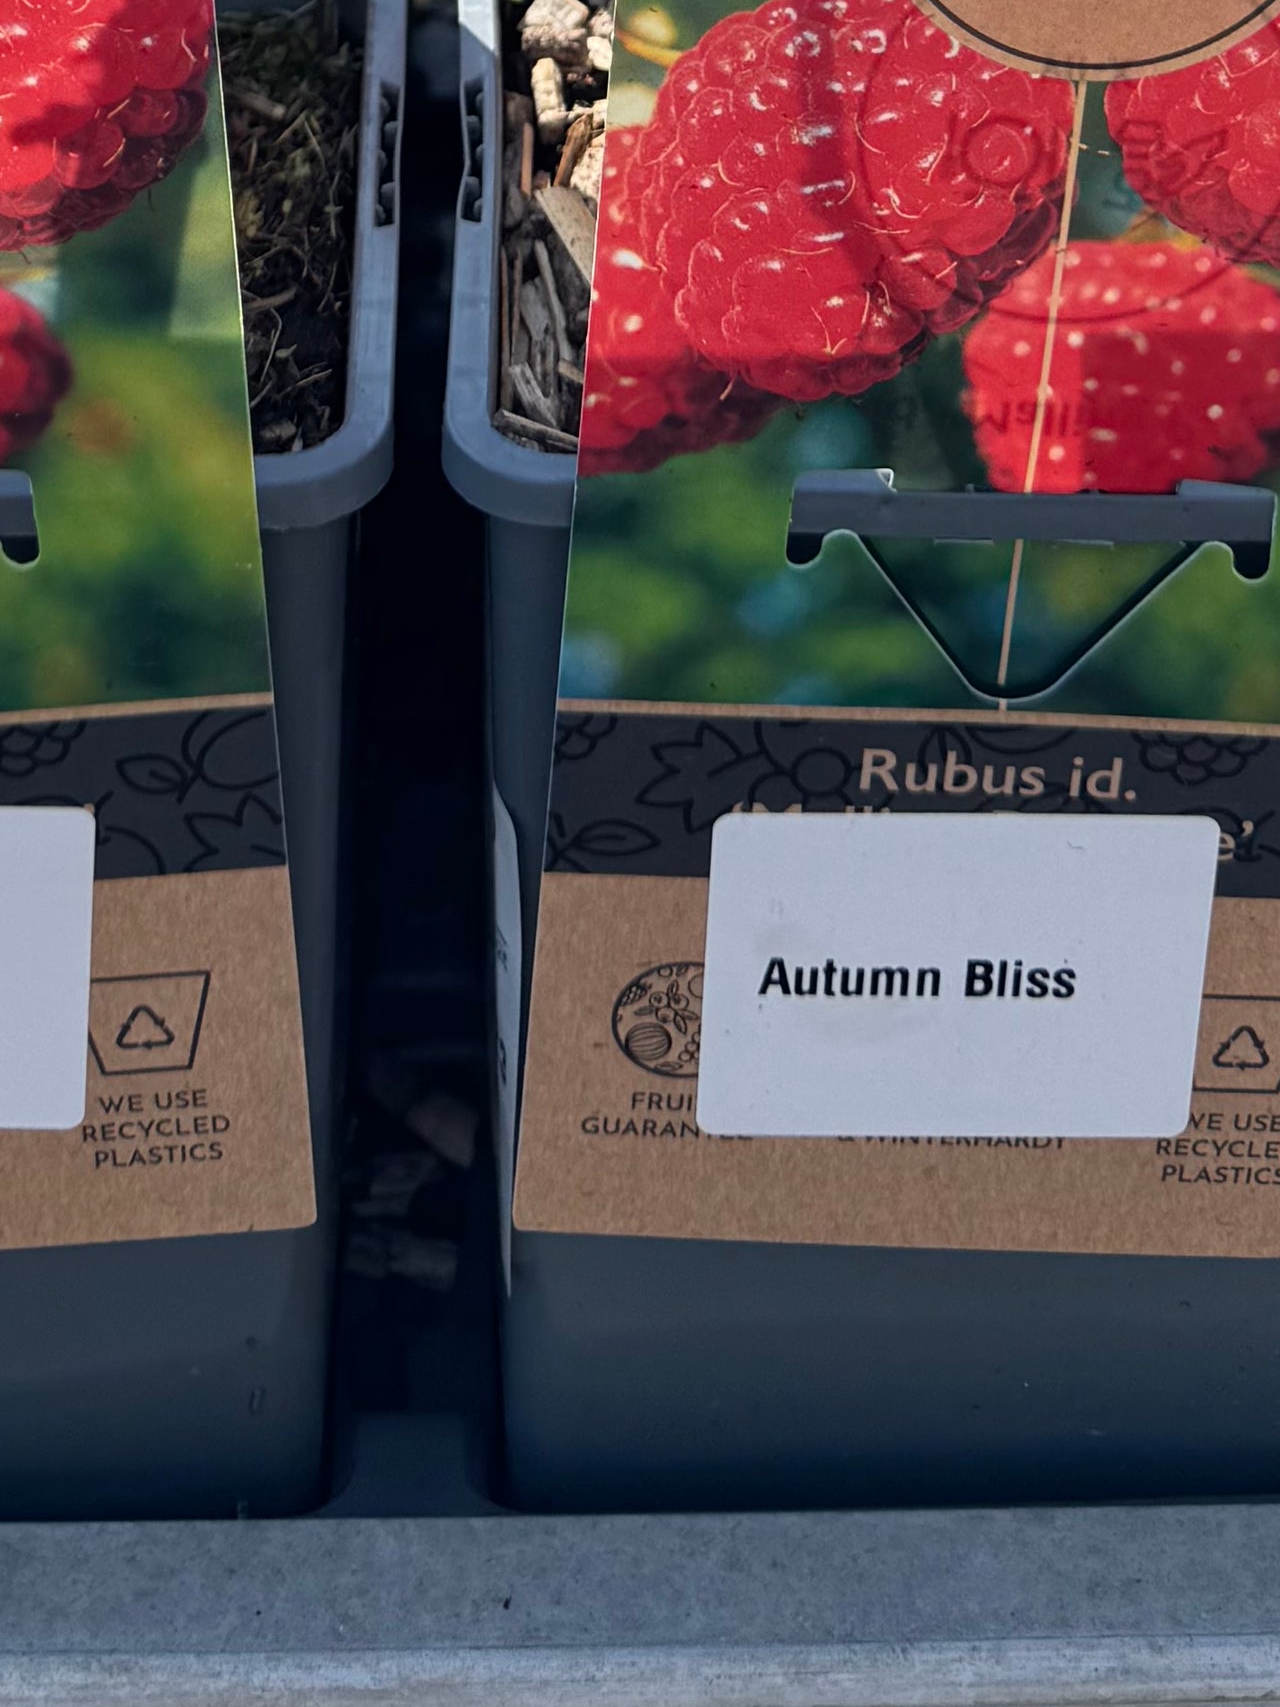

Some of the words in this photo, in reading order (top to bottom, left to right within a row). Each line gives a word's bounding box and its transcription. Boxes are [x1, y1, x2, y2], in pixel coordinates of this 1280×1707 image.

[860, 749, 1045, 795] Rubus
[1070, 757, 1135, 799] id.
[758, 958, 940, 996] Autumn
[965, 960, 1076, 998] Bliss
[98, 1094, 143, 1114] WE
[154, 1089, 207, 1110] USE
[632, 1091, 693, 1112] FRUI
[82, 1115, 230, 1143] RECYCLED
[95, 1142, 223, 1169] PLASTICS
